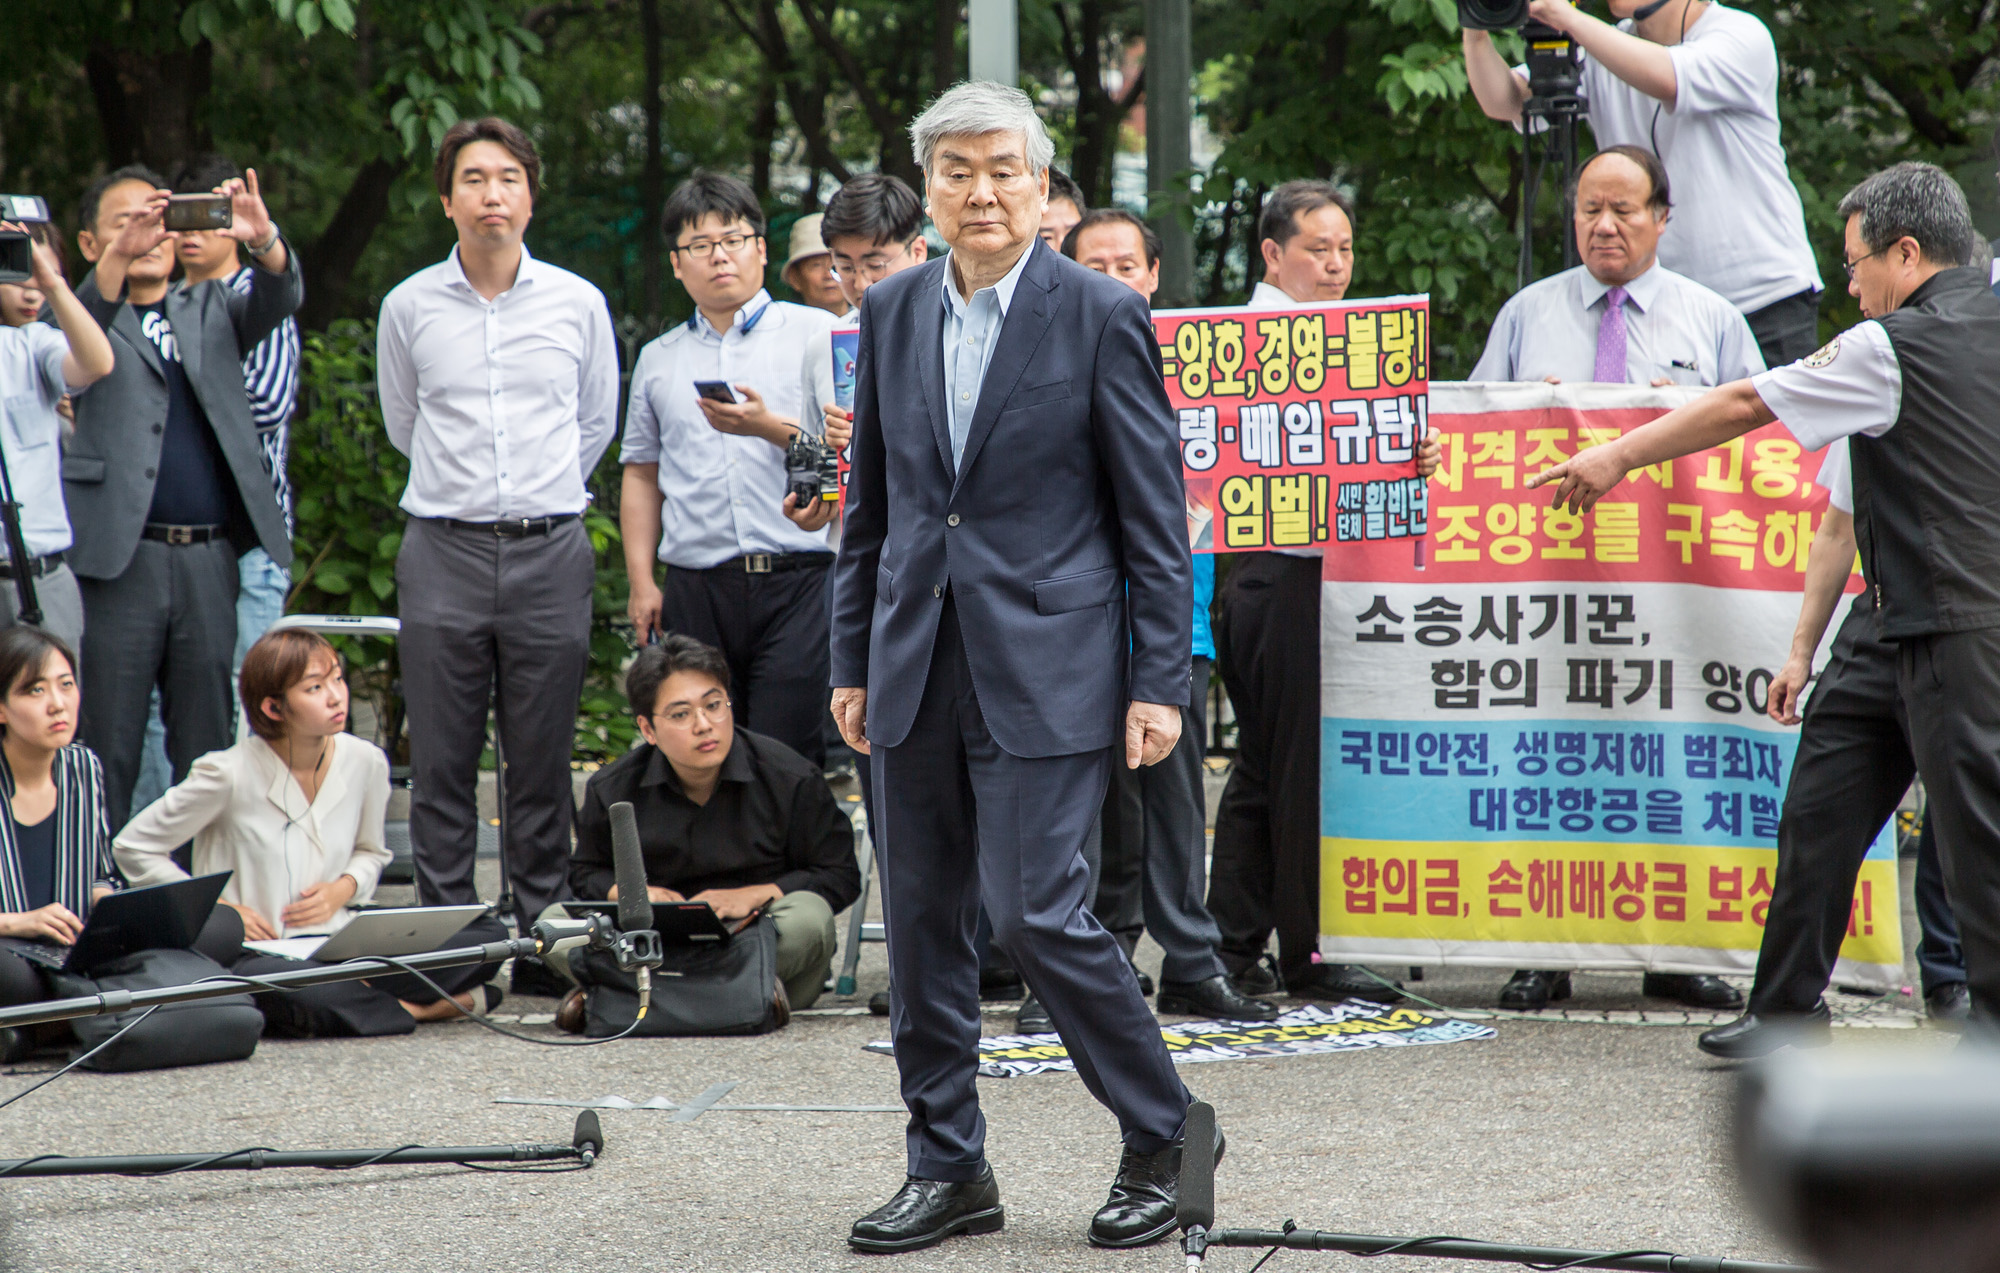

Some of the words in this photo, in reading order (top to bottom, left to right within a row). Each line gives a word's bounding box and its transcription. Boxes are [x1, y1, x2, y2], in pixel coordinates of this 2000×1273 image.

[1151, 309, 1427, 399] =양호,경영=불량!
[1176, 401, 1324, 472] 령·배임
[1331, 395, 1427, 465] 규탄!
[1336, 482, 1363, 510] 시민
[1696, 436, 1812, 499] 고용,
[1219, 473, 1330, 548] 엄벌!
[1336, 512, 1363, 541] 단체
[1364, 476, 1428, 540] 활빈단
[1434, 502, 1640, 566] 조양호를
[1665, 503, 1863, 574] 구속하
[1355, 594, 1650, 648] 소송사기꾼,
[1430, 658, 1539, 709] 합의
[1566, 659, 1674, 710] 파기
[1340, 730, 1499, 778] 국민안전,
[1513, 731, 1665, 779] 생명저해
[1684, 733, 1783, 788] 범죄자
[1468, 787, 1683, 834] 대한항공을
[1702, 791, 1780, 839] 처벌
[1341, 856, 1470, 919] 합의금,
[1487, 859, 1687, 922] 손해배상금
